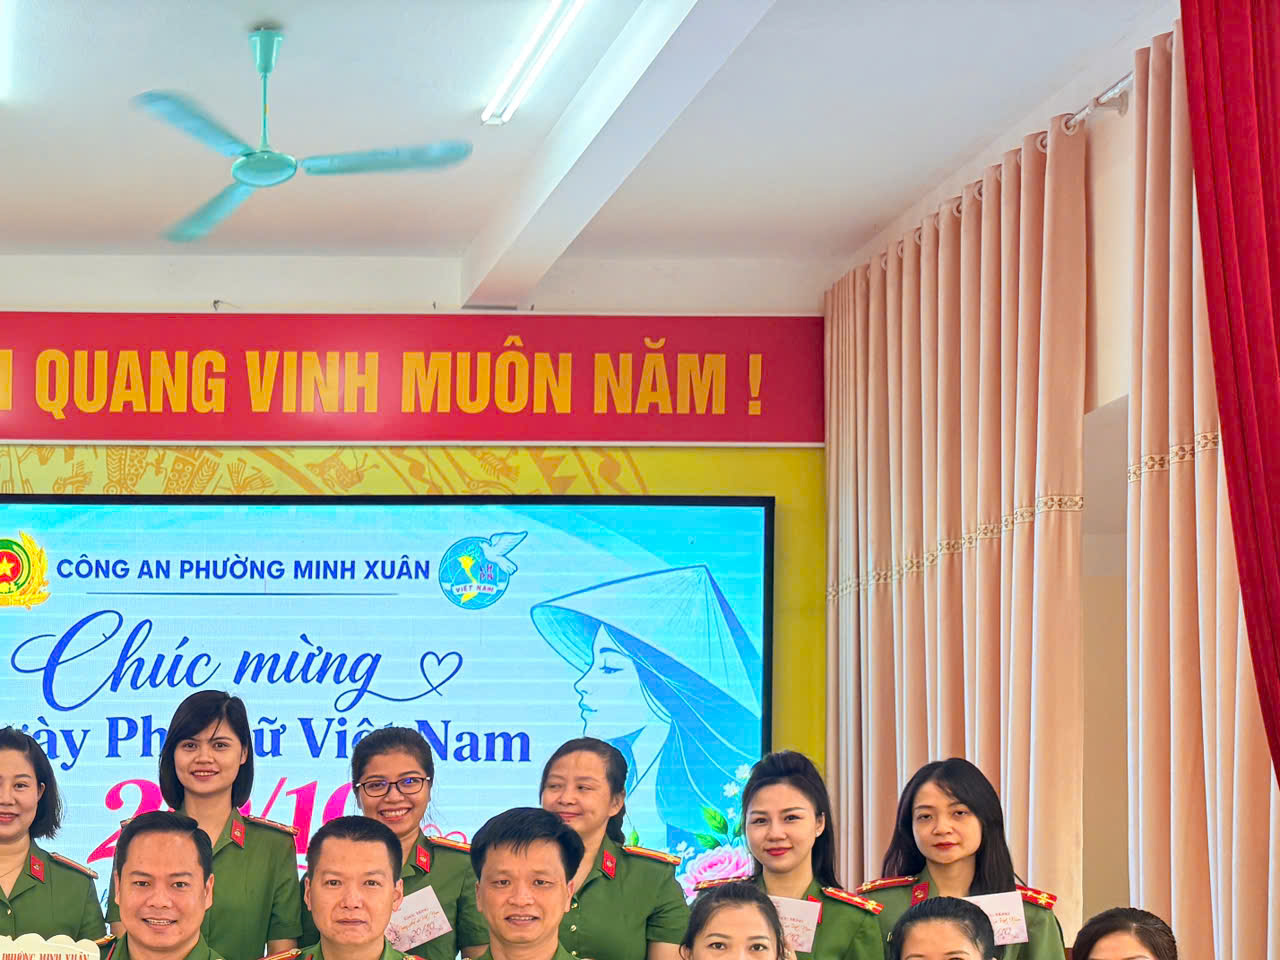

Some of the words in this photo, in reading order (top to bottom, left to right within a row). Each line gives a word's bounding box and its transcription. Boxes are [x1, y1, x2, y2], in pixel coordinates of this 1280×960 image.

[35, 349, 226, 419] QUANG
[246, 352, 378, 413] VINH
[402, 336, 572, 414] MUÔN
[594, 337, 725, 415] NĂM
[56, 553, 130, 579] CÔNG
[137, 559, 171, 579] AN
[180, 553, 285, 580] PHƯỜNG
[293, 560, 356, 580] MINH
[364, 554, 430, 580] XUÂN
[11, 609, 221, 712] Chúc
[233, 633, 384, 713] mừng
[105, 714, 169, 758] Ph
[297, 717, 395, 759] Vi
[414, 719, 532, 762] Nam
[86, 777, 352, 864] 2/1
